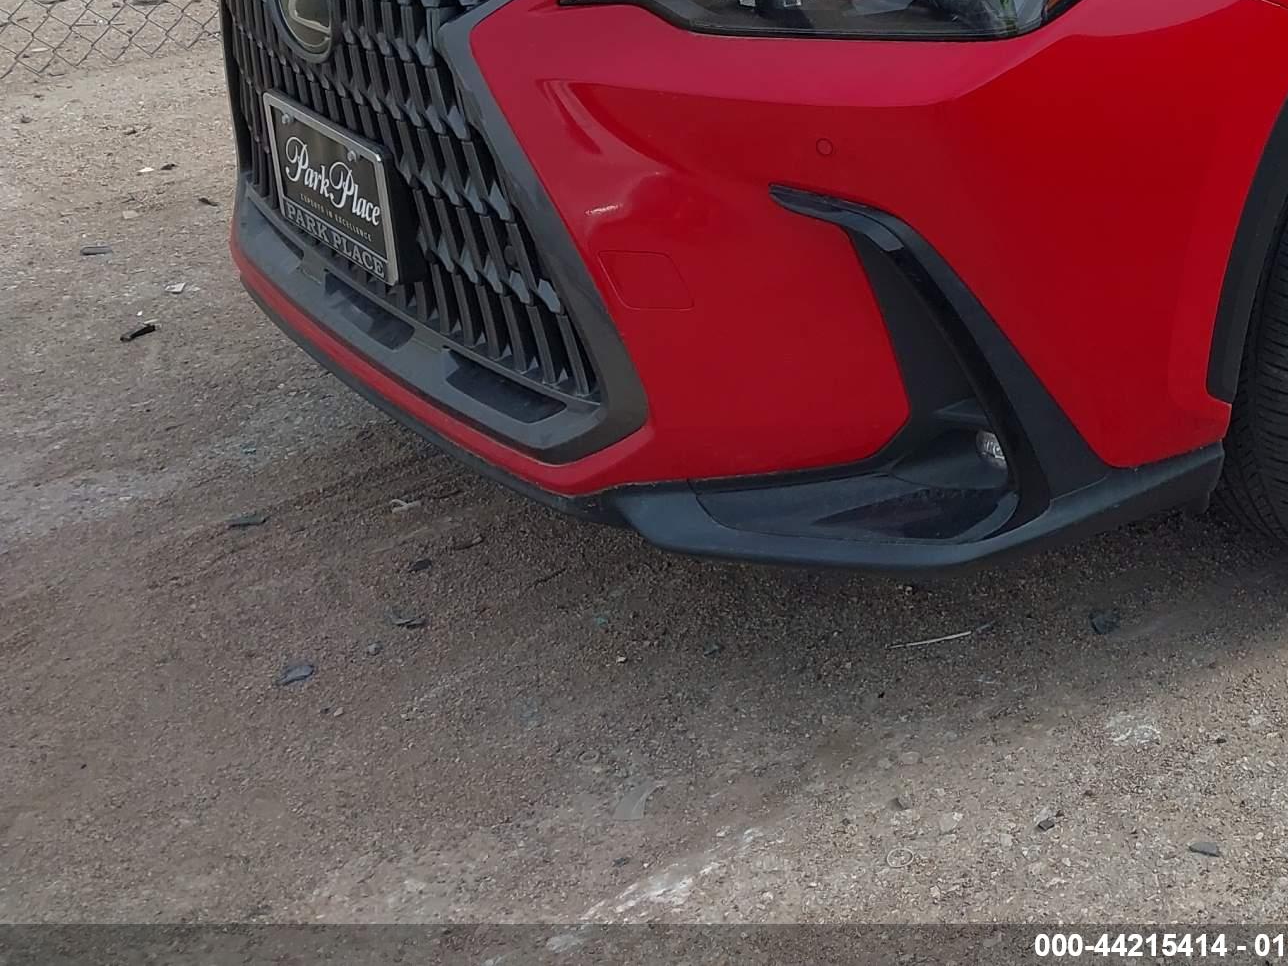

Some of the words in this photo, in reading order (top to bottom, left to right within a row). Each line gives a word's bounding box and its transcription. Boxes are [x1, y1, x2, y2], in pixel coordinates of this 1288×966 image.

[285, 136, 330, 198] Park
[329, 161, 381, 226] Place
[286, 202, 330, 244] PARK
[332, 232, 385, 279] PLACE
